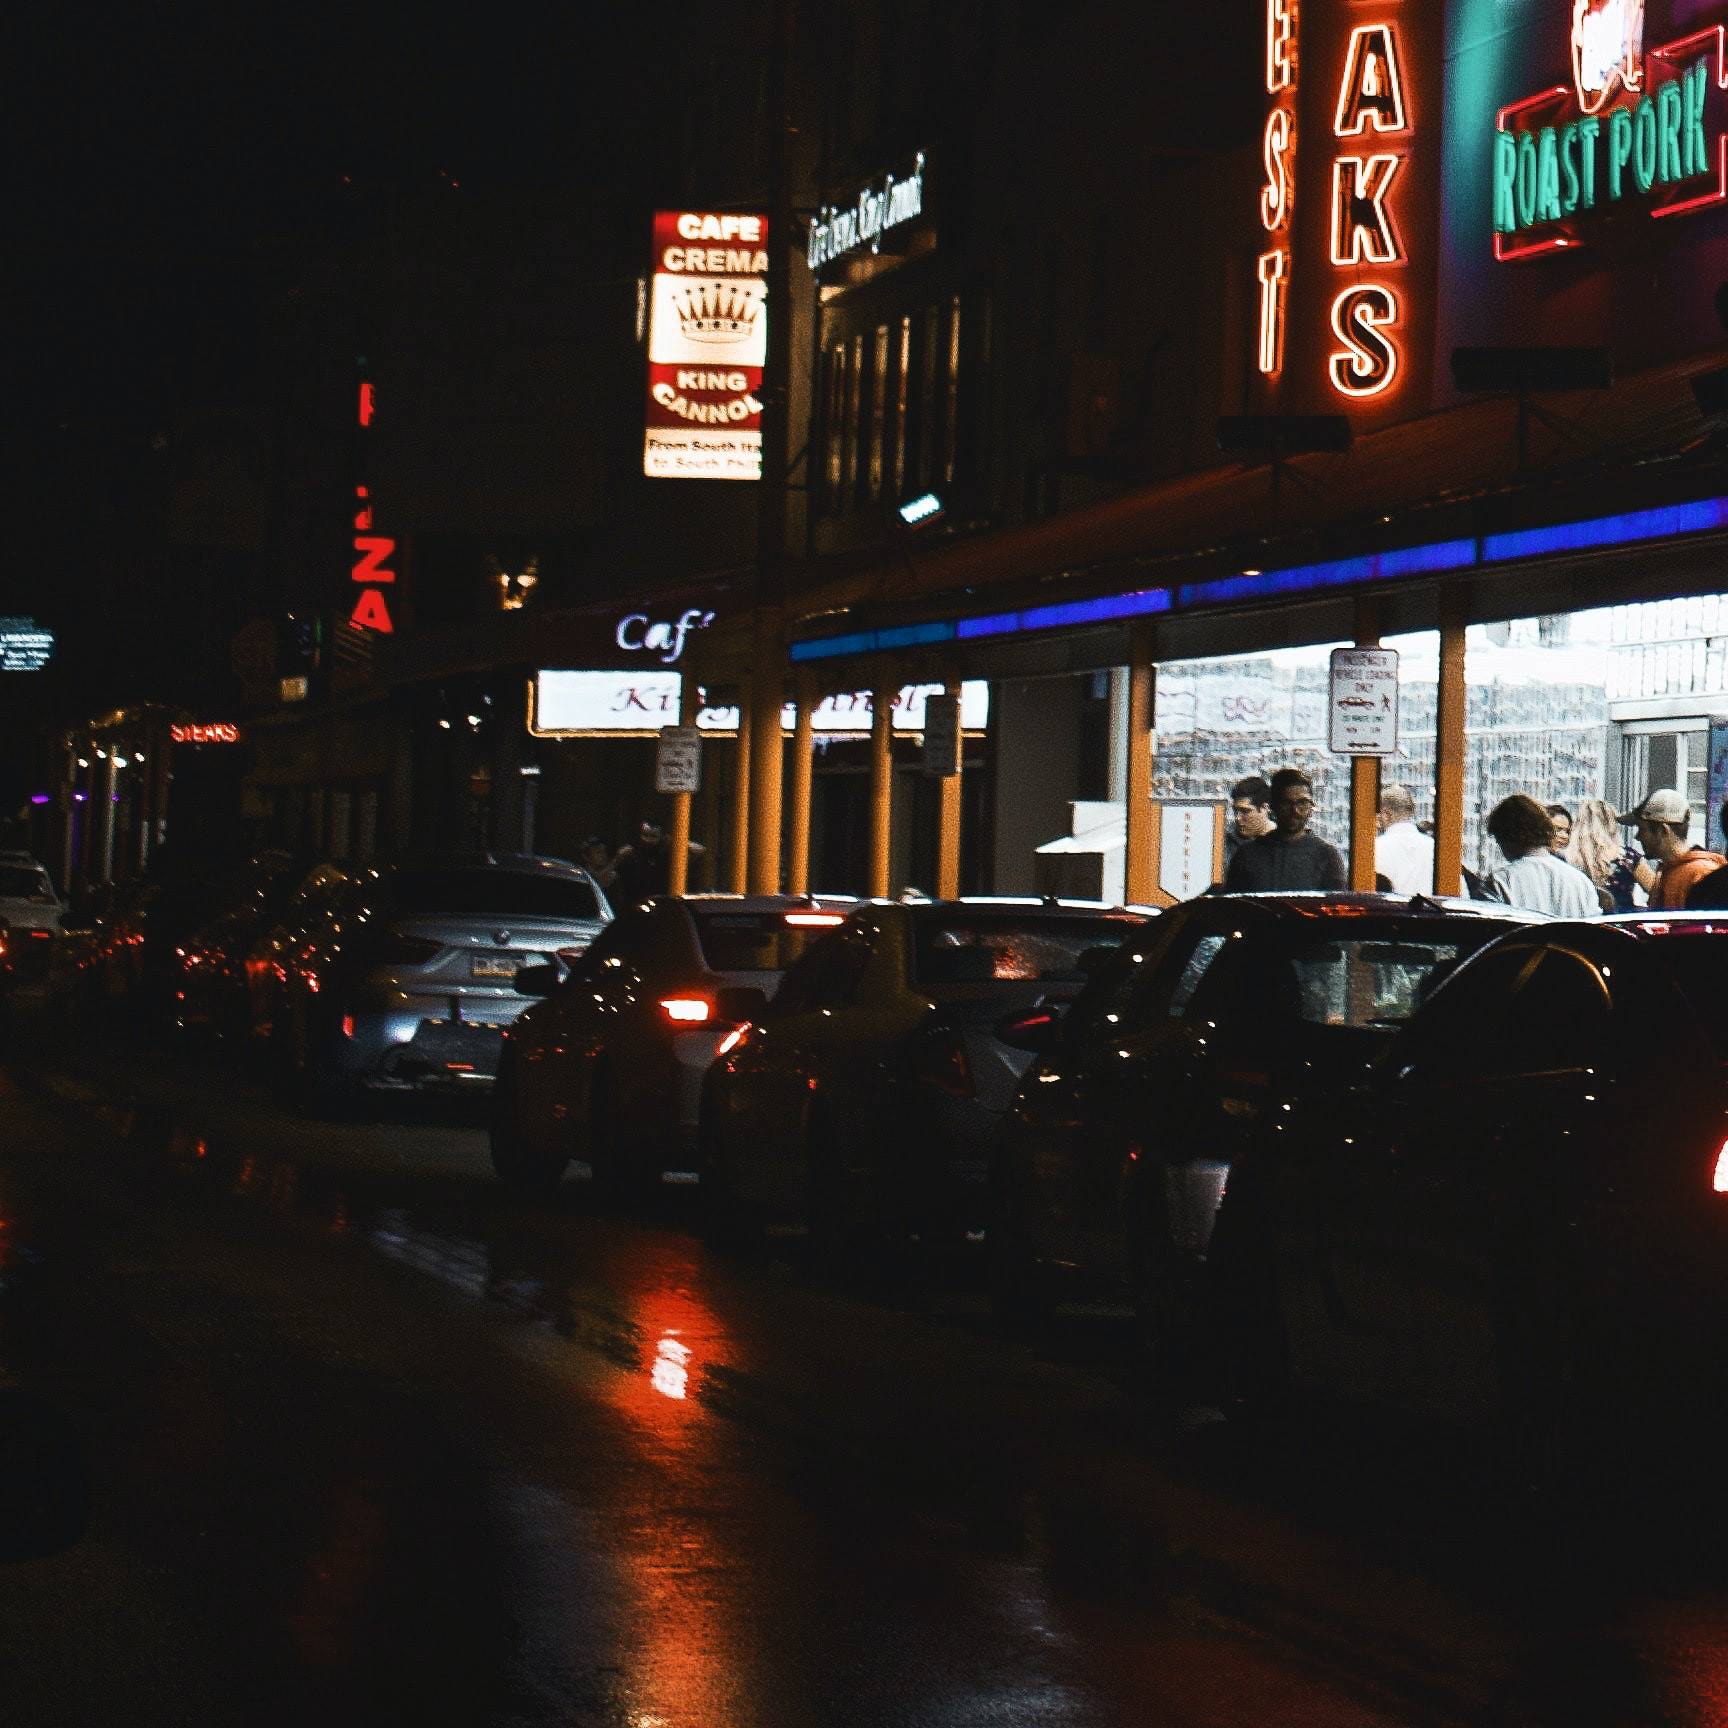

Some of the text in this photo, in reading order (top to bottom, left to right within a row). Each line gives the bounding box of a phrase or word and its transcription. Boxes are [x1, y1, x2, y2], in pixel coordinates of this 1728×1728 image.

[1492, 56, 1709, 233] ROAST PORK
[677, 213, 761, 242] CAFE
[663, 248, 768, 273] CREMA
[677, 370, 748, 392] KING
[653, 383, 764, 424] CANNOL
[616, 610, 715, 663] Caf
